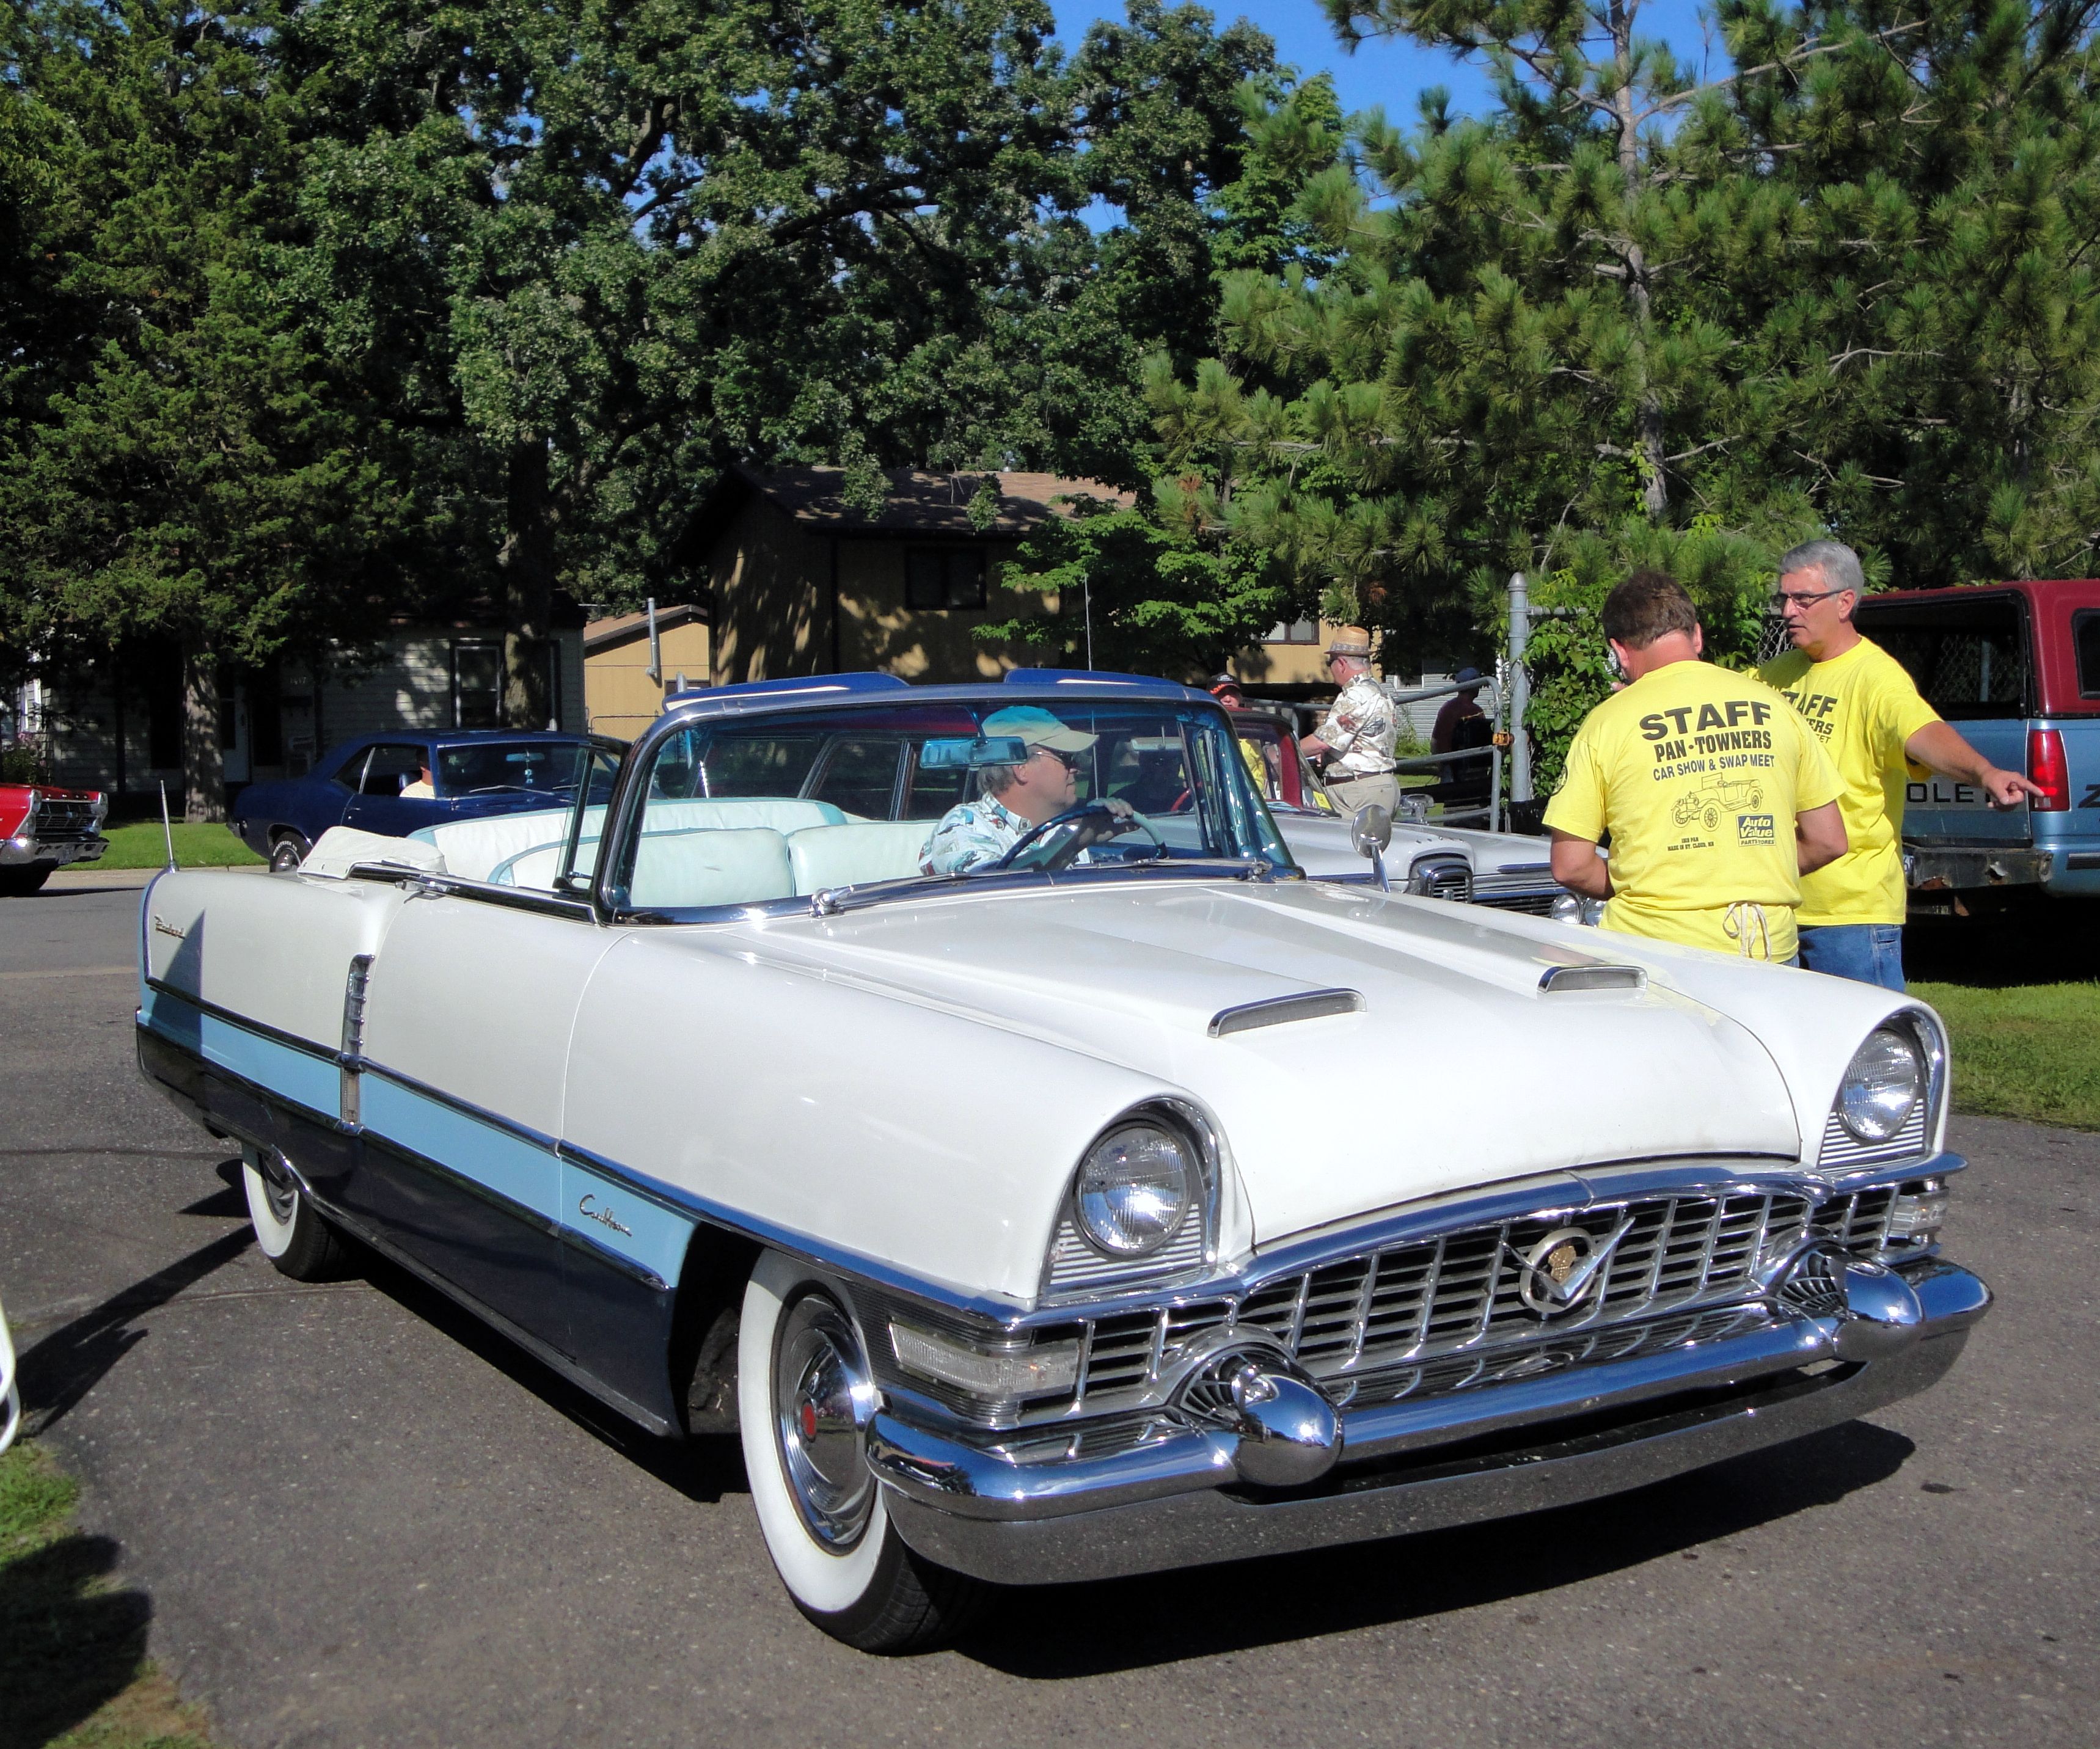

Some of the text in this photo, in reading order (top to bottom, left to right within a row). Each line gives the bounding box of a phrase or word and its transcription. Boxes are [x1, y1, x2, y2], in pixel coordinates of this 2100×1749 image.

[1639, 701, 1771, 740] STAFF
[1653, 754, 1774, 781] CAR SHOW & SWAP MEET
[1741, 816, 1771, 827] Auto
[1740, 827, 1773, 838] Value
